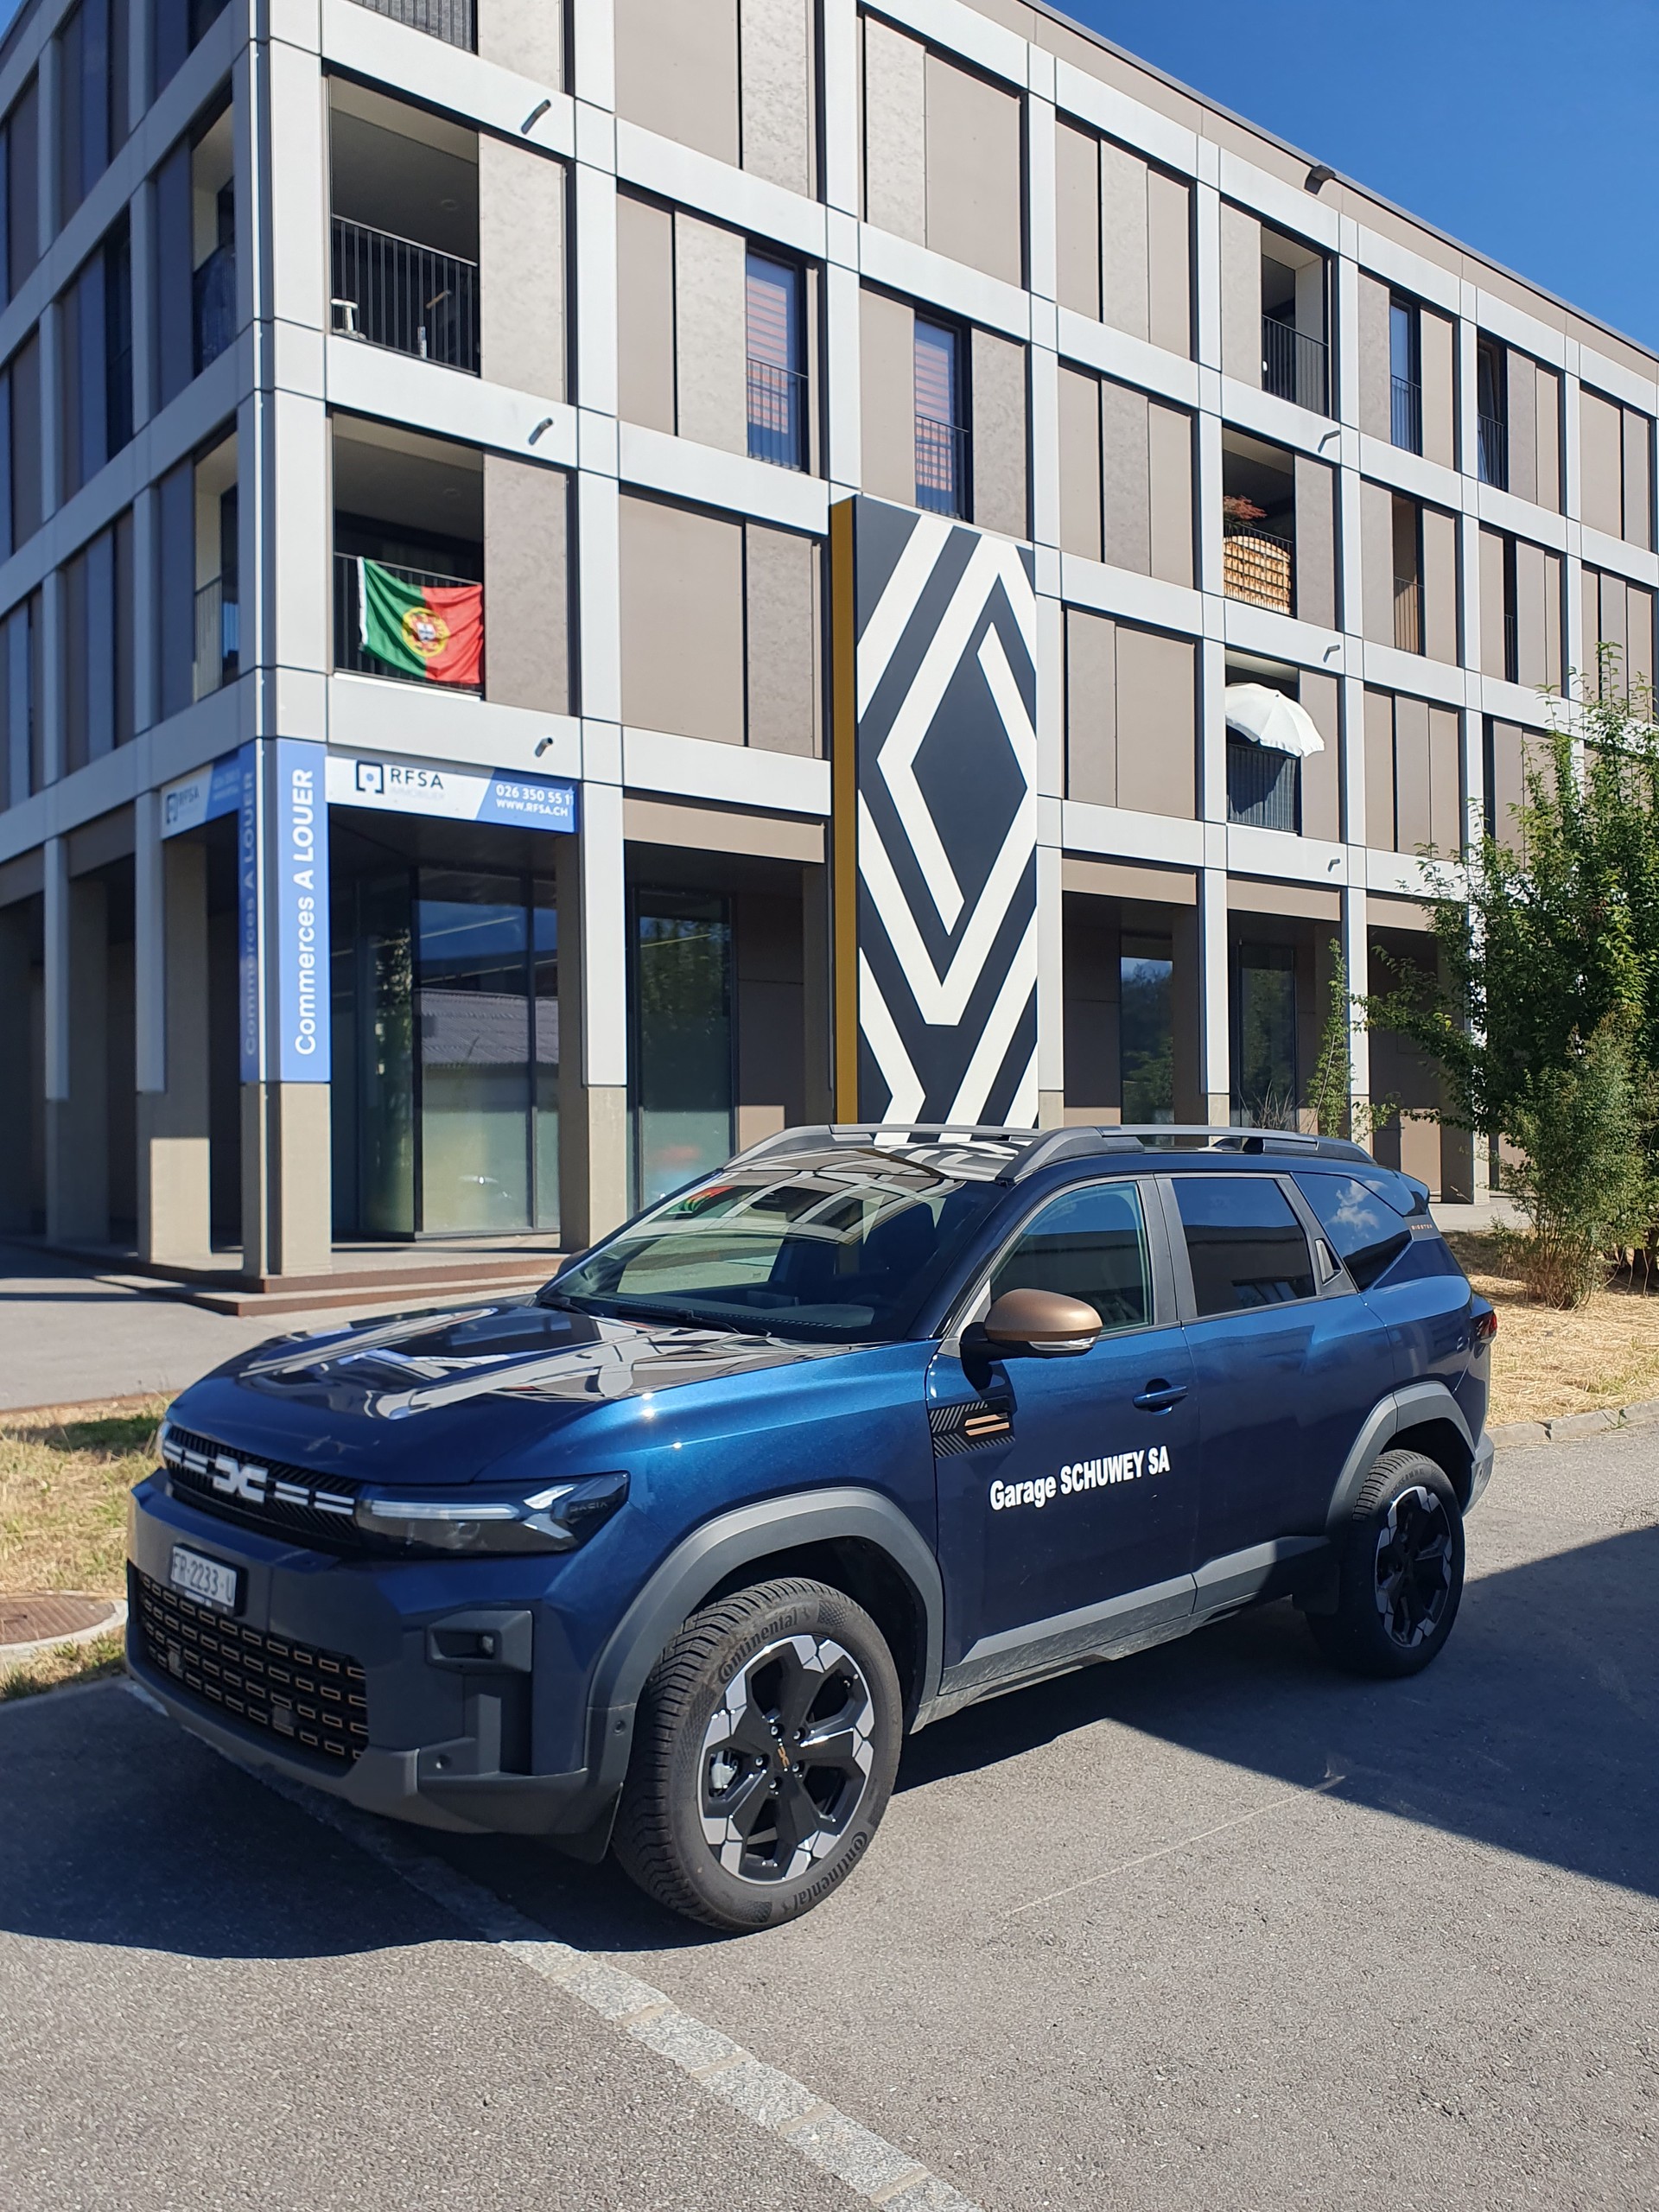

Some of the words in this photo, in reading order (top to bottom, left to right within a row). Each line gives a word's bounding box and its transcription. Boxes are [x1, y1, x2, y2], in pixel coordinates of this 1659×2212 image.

[391, 768, 443, 790] RFSA
[496, 784, 519, 798] 026
[522, 787, 545, 802] 350
[548, 791, 563, 804] 55
[496, 798, 569, 817] WWW.RFSA.CH
[292, 768, 314, 862] LOUER
[293, 869, 315, 890] A
[295, 896, 316, 1055] Commerces
[989, 1476, 1057, 1510] Garage
[1059, 1450, 1145, 1495] SCHUWEY
[1147, 1446, 1171, 1475] SA
[718, 1605, 798, 1684] Continental
[793, 1831, 868, 1911] Continental
